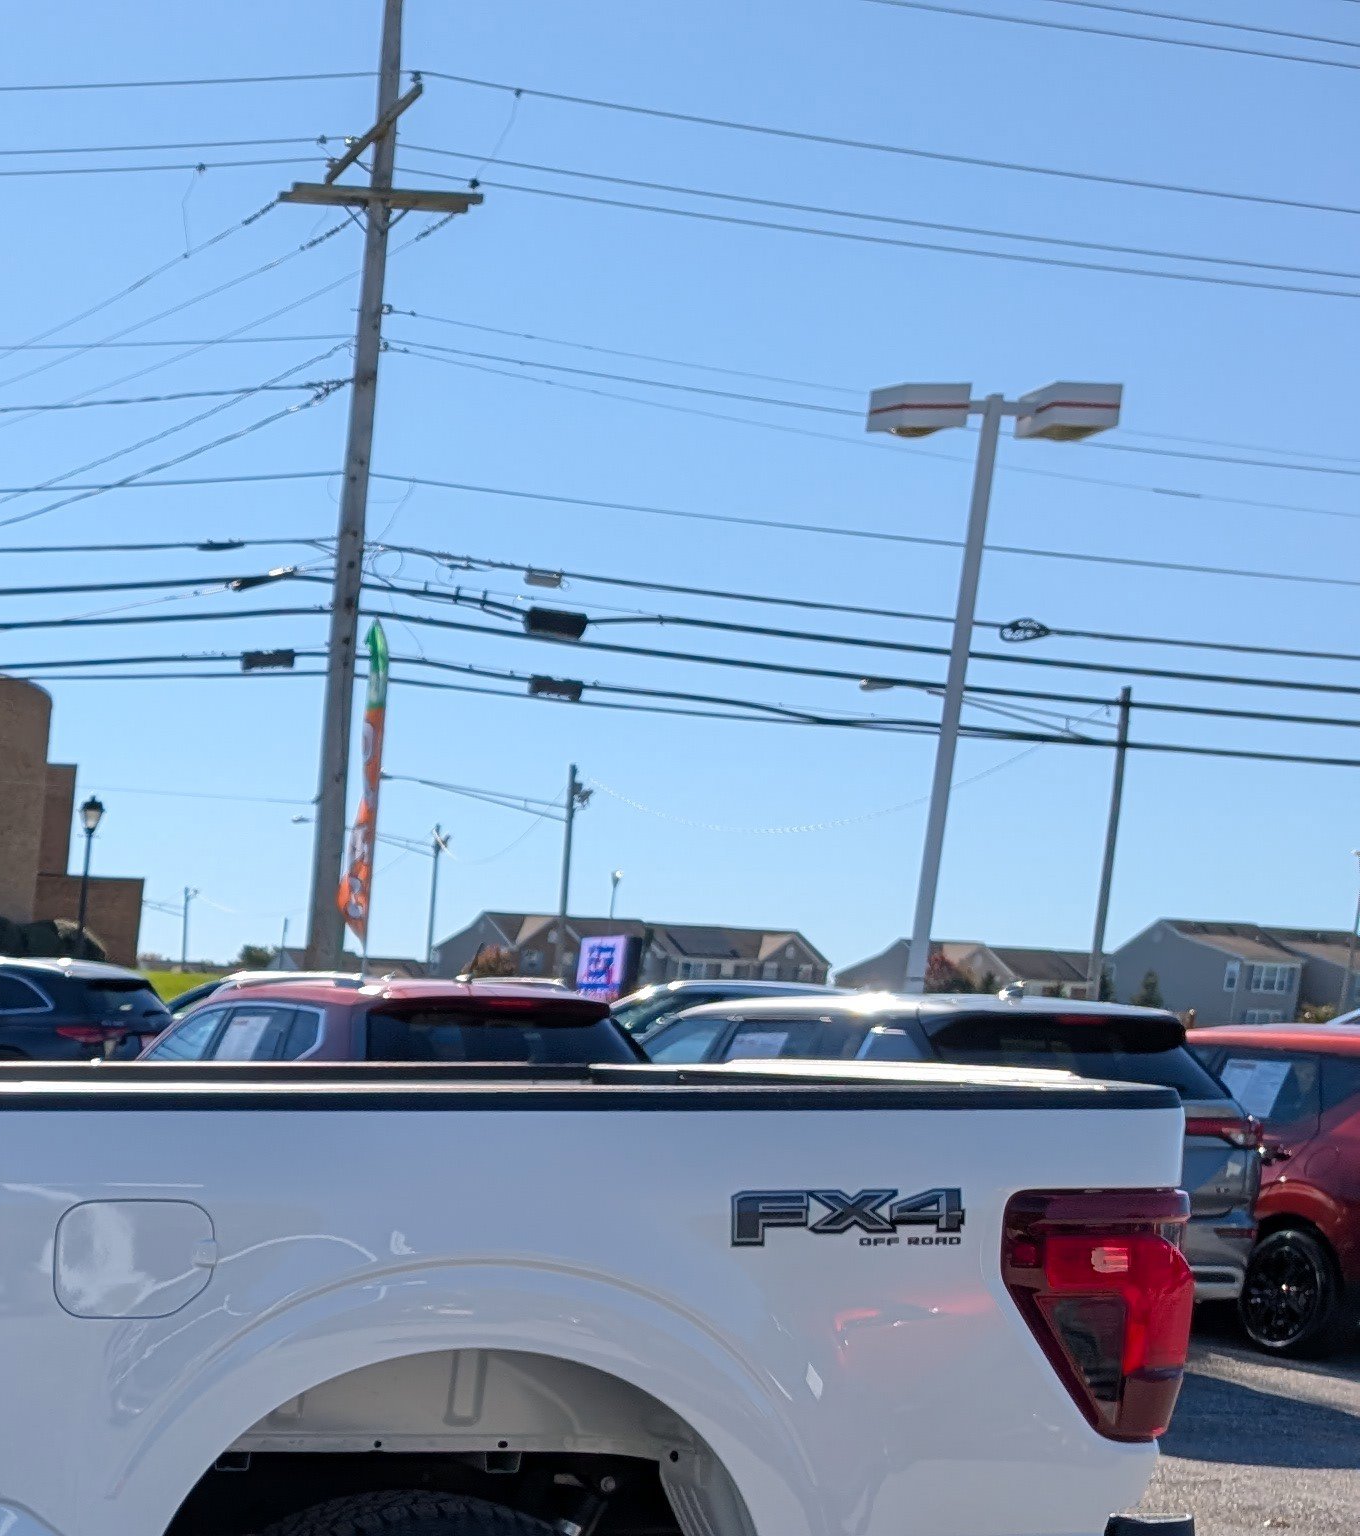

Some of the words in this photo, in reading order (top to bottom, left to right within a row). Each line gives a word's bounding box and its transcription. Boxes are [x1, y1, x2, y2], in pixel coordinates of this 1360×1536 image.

[731, 1188, 966, 1247] FX4
[859, 1237, 900, 1247] OFF
[907, 1236, 962, 1246] ROAD
